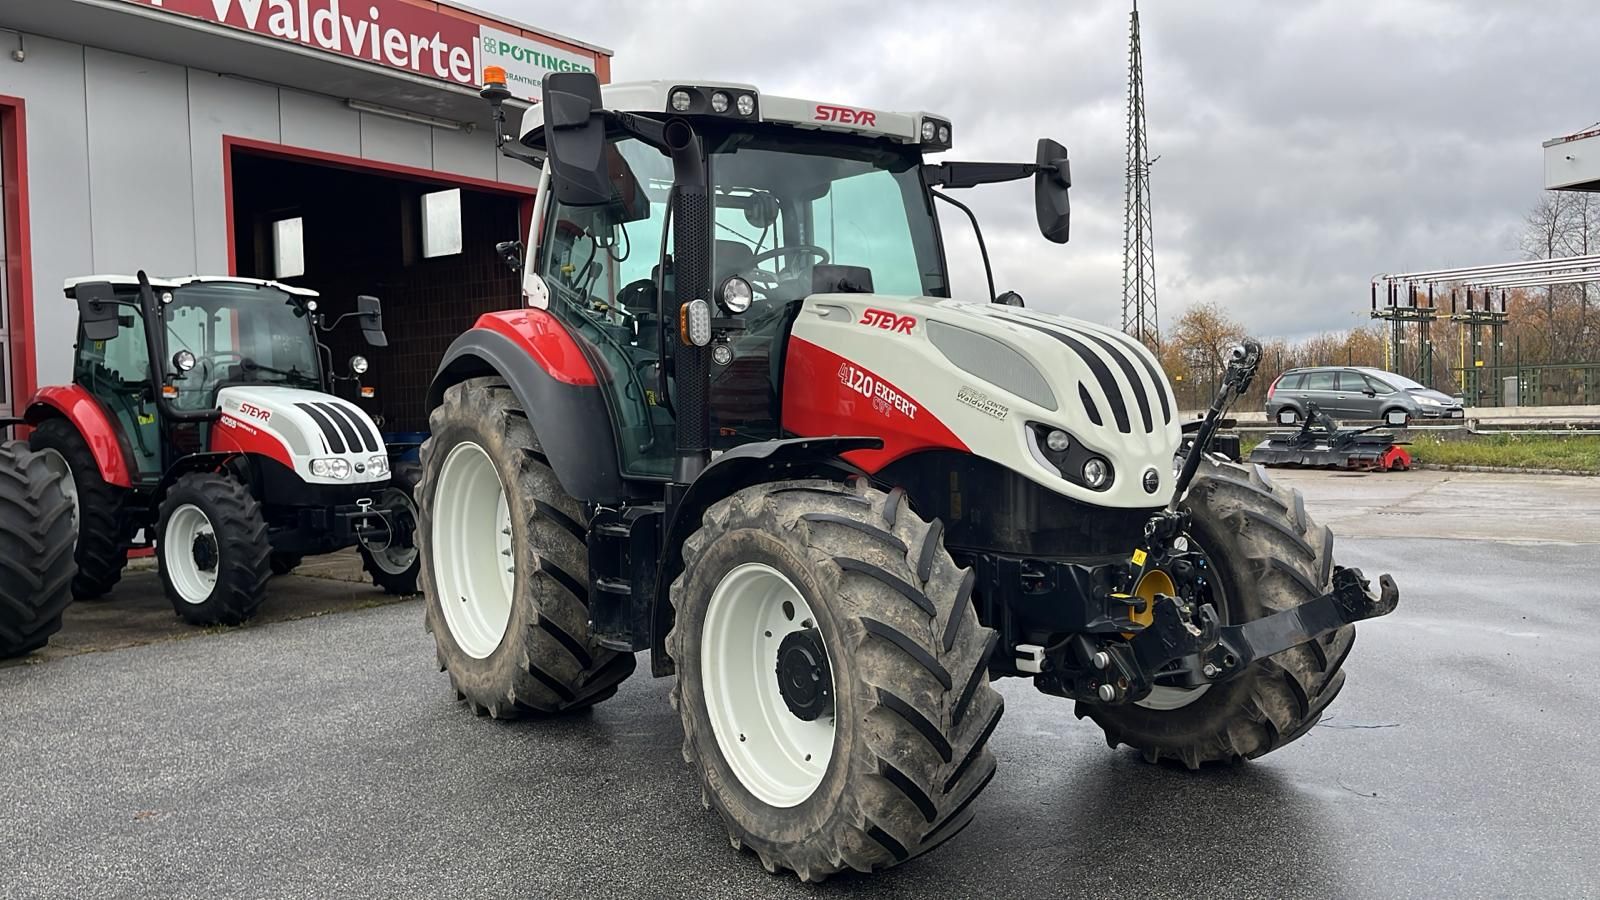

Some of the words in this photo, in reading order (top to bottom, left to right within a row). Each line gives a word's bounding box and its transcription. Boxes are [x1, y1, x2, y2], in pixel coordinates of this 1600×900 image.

[814, 105, 876, 127] STEYR
[859, 308, 917, 336] STEYR
[838, 362, 874, 398] 4120
[874, 381, 918, 420] EXPERT
[239, 403, 271, 422] STEYR
[957, 392, 1008, 418] Waldviertel
[986, 400, 1009, 412] CENTER
